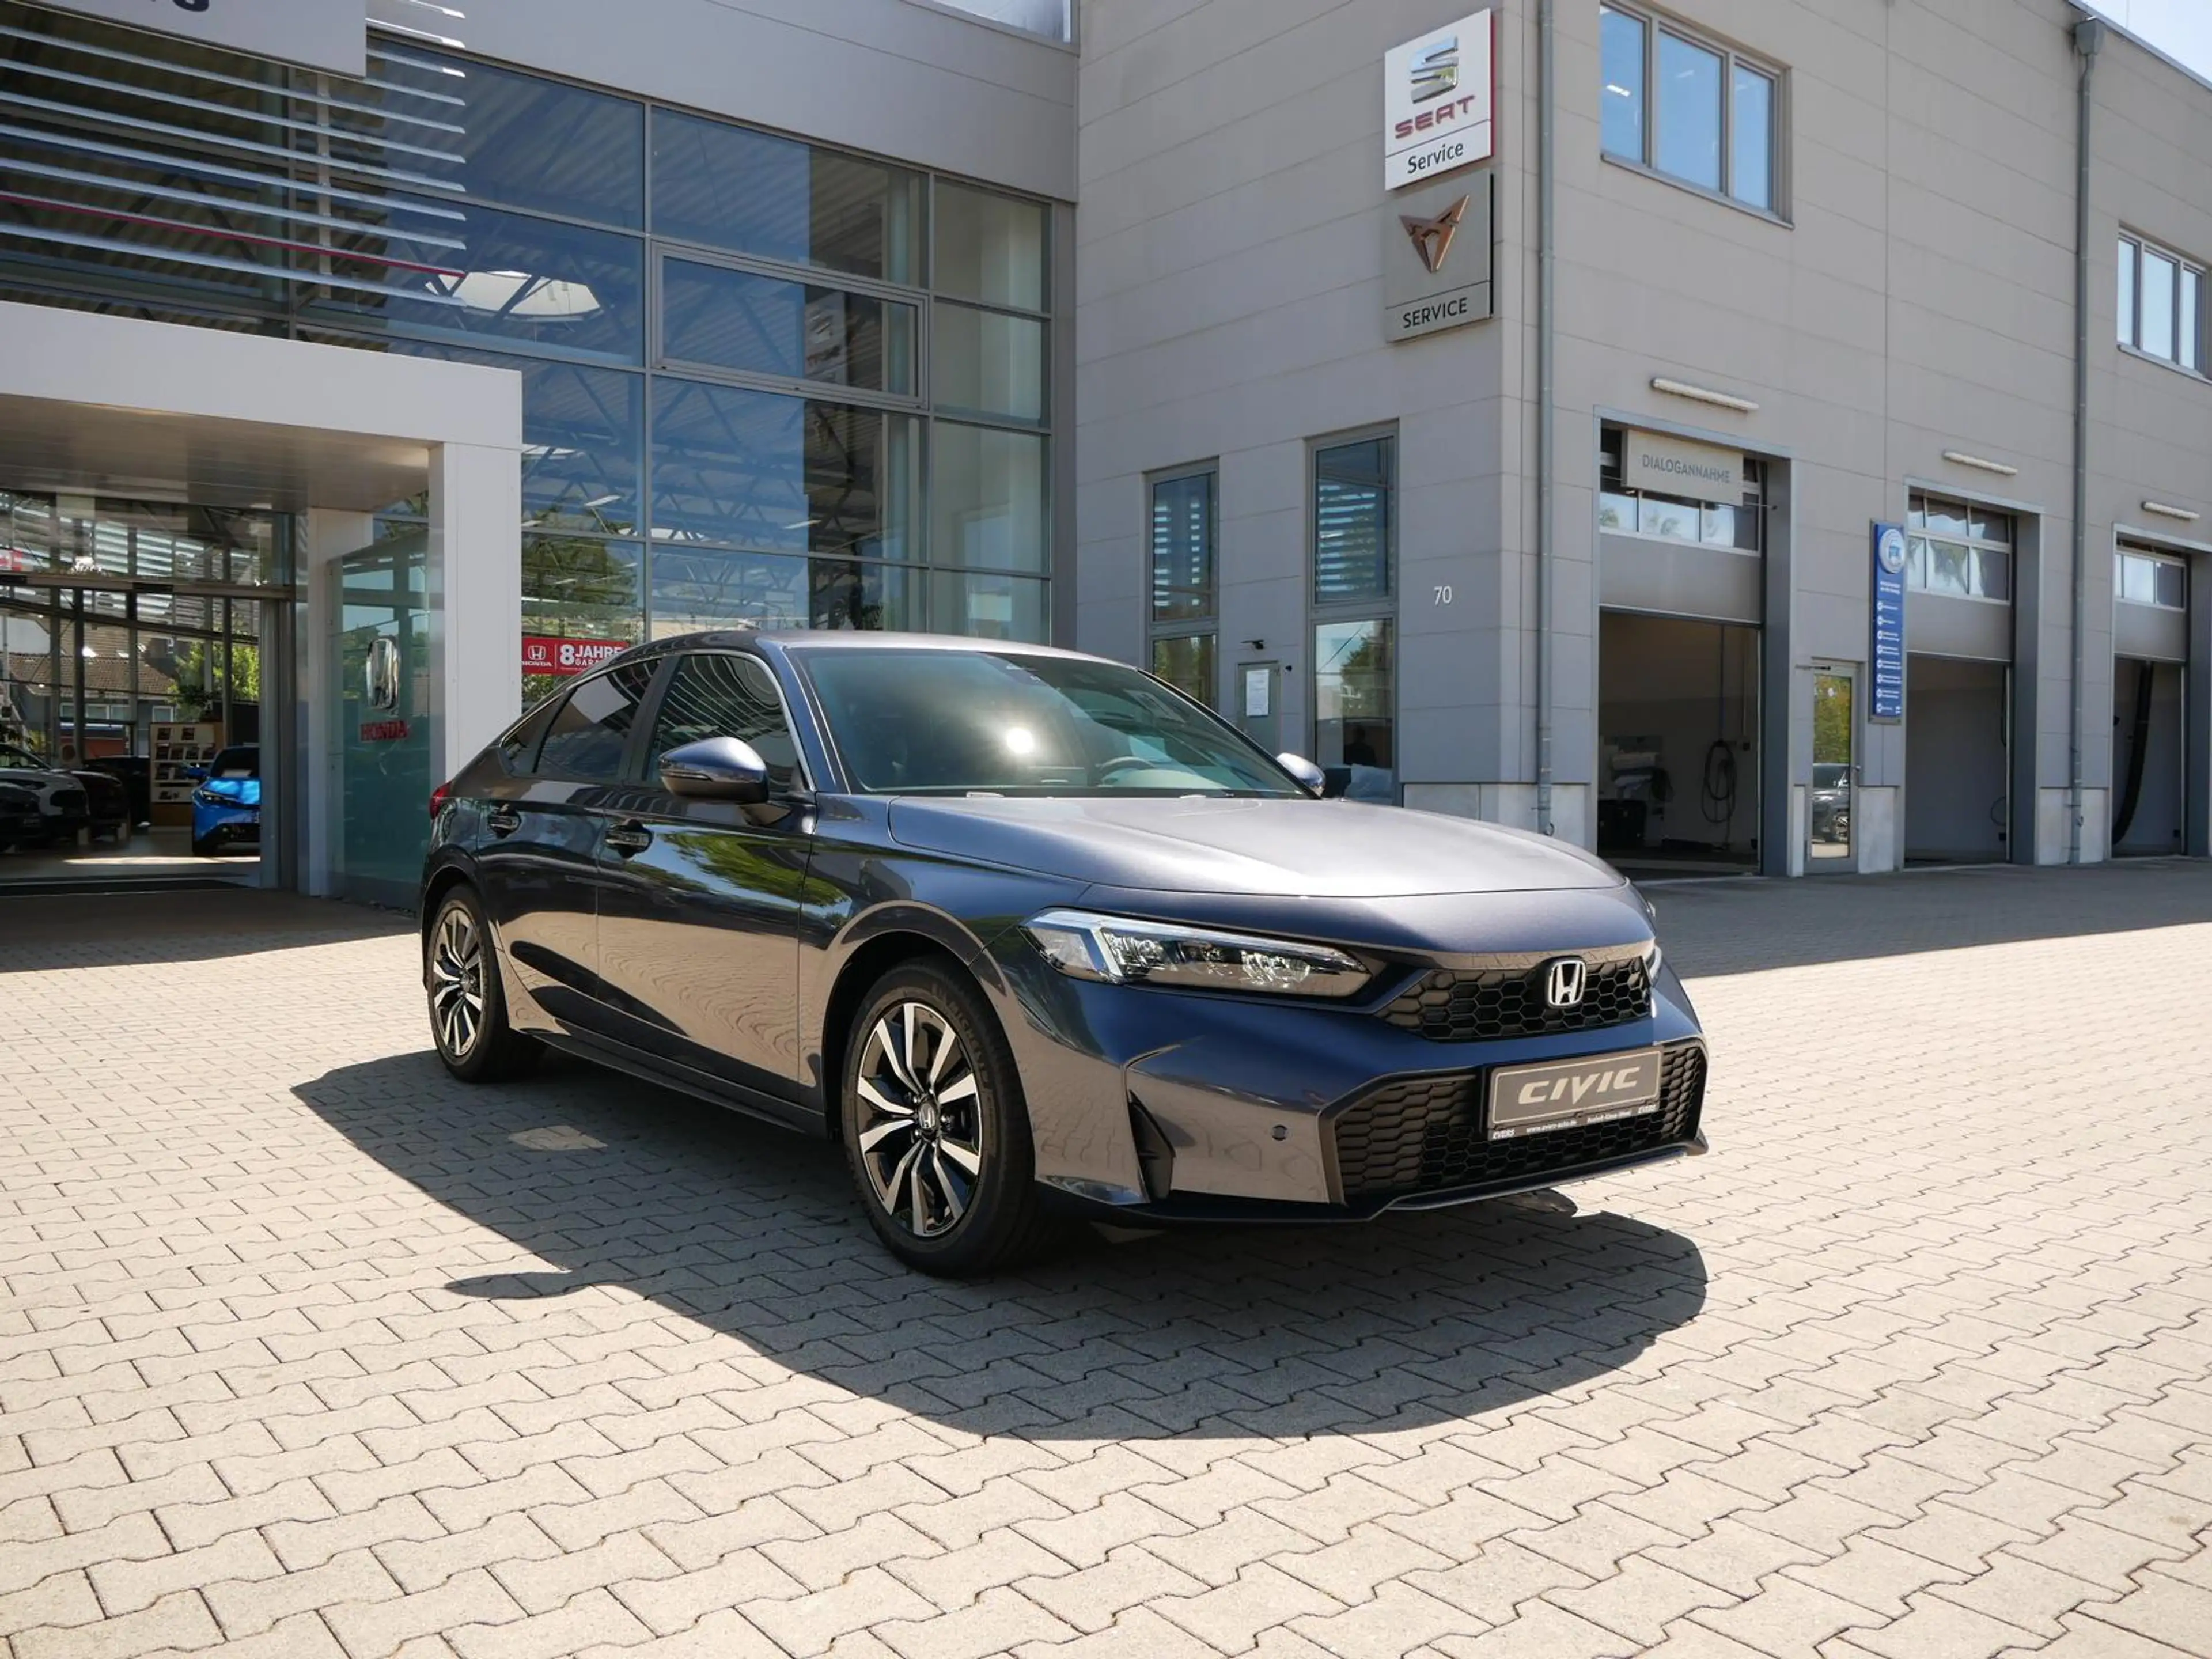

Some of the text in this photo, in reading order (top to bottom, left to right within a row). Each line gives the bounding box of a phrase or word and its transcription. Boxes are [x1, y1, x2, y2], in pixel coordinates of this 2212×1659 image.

[1395, 94, 1476, 139] SEAT
[1407, 140, 1464, 175] Service
[1403, 297, 1468, 328] SERVICE
[1642, 454, 1731, 483] DIALOGANNAHME
[1433, 585, 1453, 605] 70
[560, 644, 575, 665] 8
[360, 720, 408, 741] HONDA
[1518, 1066, 1641, 1105] CIVIC
